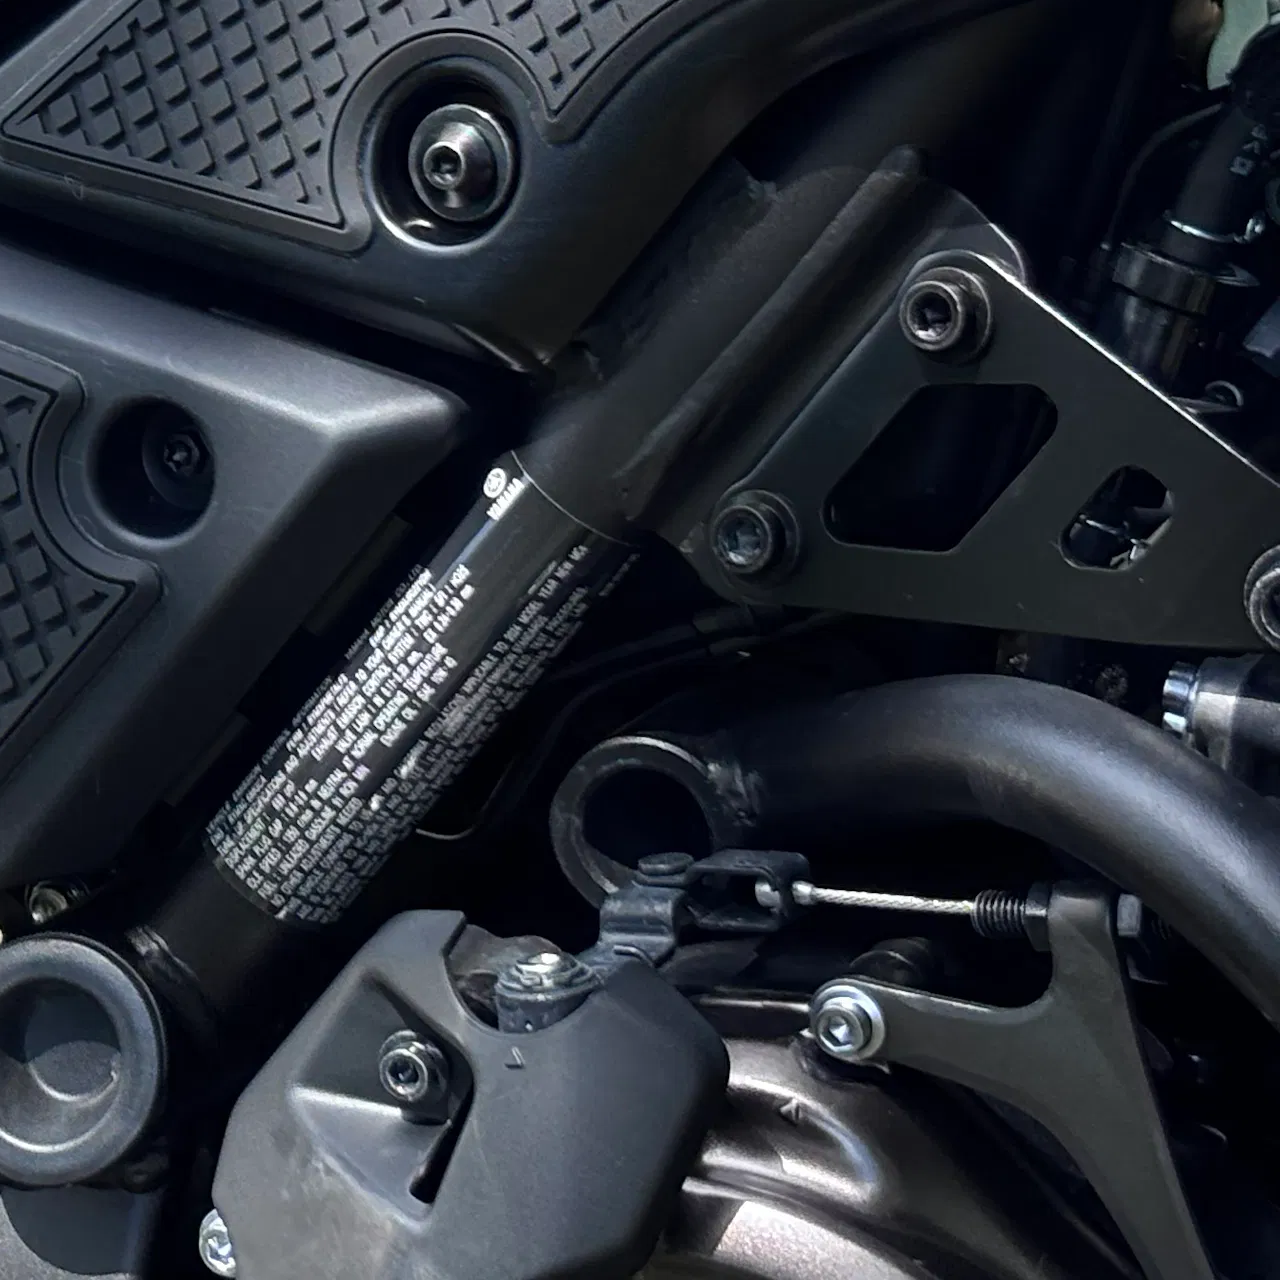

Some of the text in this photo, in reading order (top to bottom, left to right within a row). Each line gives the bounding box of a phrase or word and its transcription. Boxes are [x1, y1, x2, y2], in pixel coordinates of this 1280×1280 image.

[361, 662, 392, 697] CONTROL
[383, 632, 415, 664] SYSTEM
[334, 728, 357, 753] VALVE
[351, 709, 372, 733] LASH
[379, 717, 407, 747] ENGINE
[415, 682, 435, 701] SAE
[258, 847, 281, 873] SPEED
[316, 767, 347, 800] NEUTRAL
[341, 754, 354, 770] AT
[350, 728, 378, 758] NORMAL
[372, 689, 408, 730] OPERATING
[402, 642, 448, 692] TEMPERATURE
[269, 892, 285, 907] NO
[279, 868, 304, 894] OTHER
[299, 823, 341, 871] ADJUSTMENTS
[277, 838, 309, 875] UNLEADED
[304, 804, 336, 840] GASOLINE
